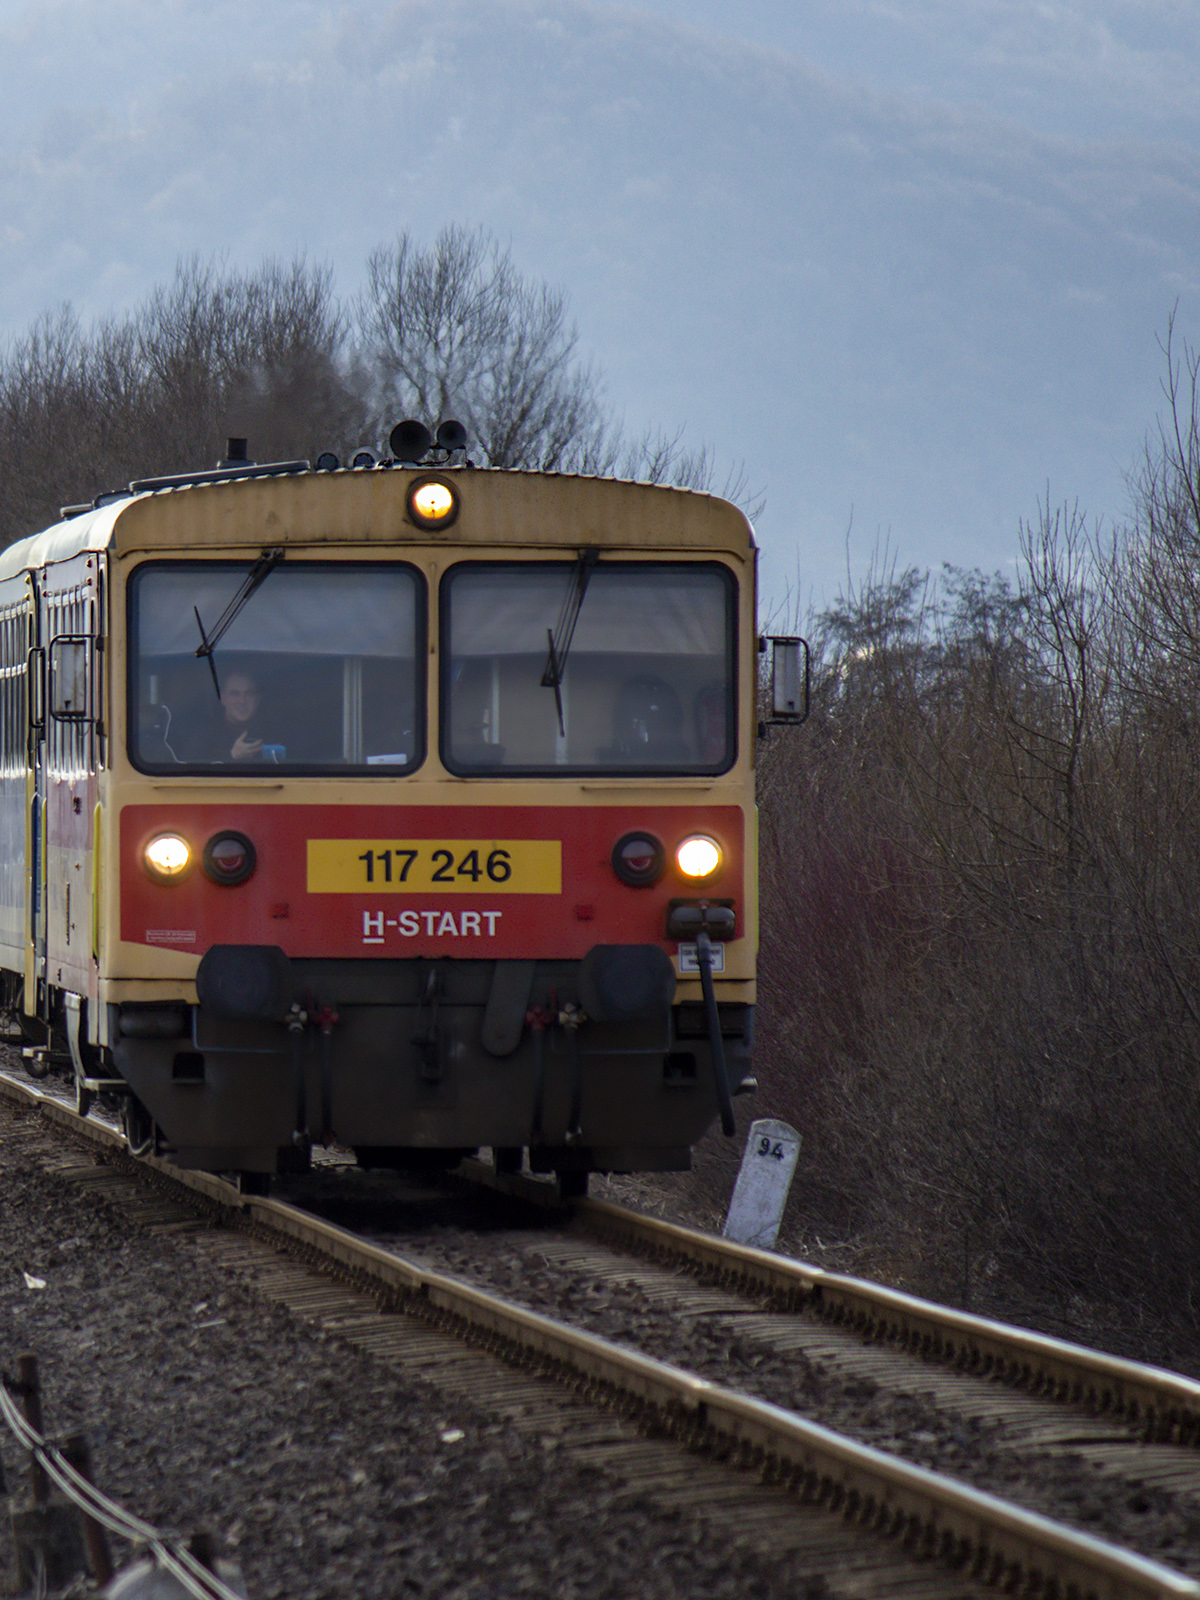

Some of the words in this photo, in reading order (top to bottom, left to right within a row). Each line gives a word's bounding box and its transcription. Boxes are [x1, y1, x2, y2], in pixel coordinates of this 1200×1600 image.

[358, 849, 419, 883] 117
[431, 849, 513, 883] 246
[362, 910, 503, 943] H-START
[757, 1137, 785, 1162] 94
